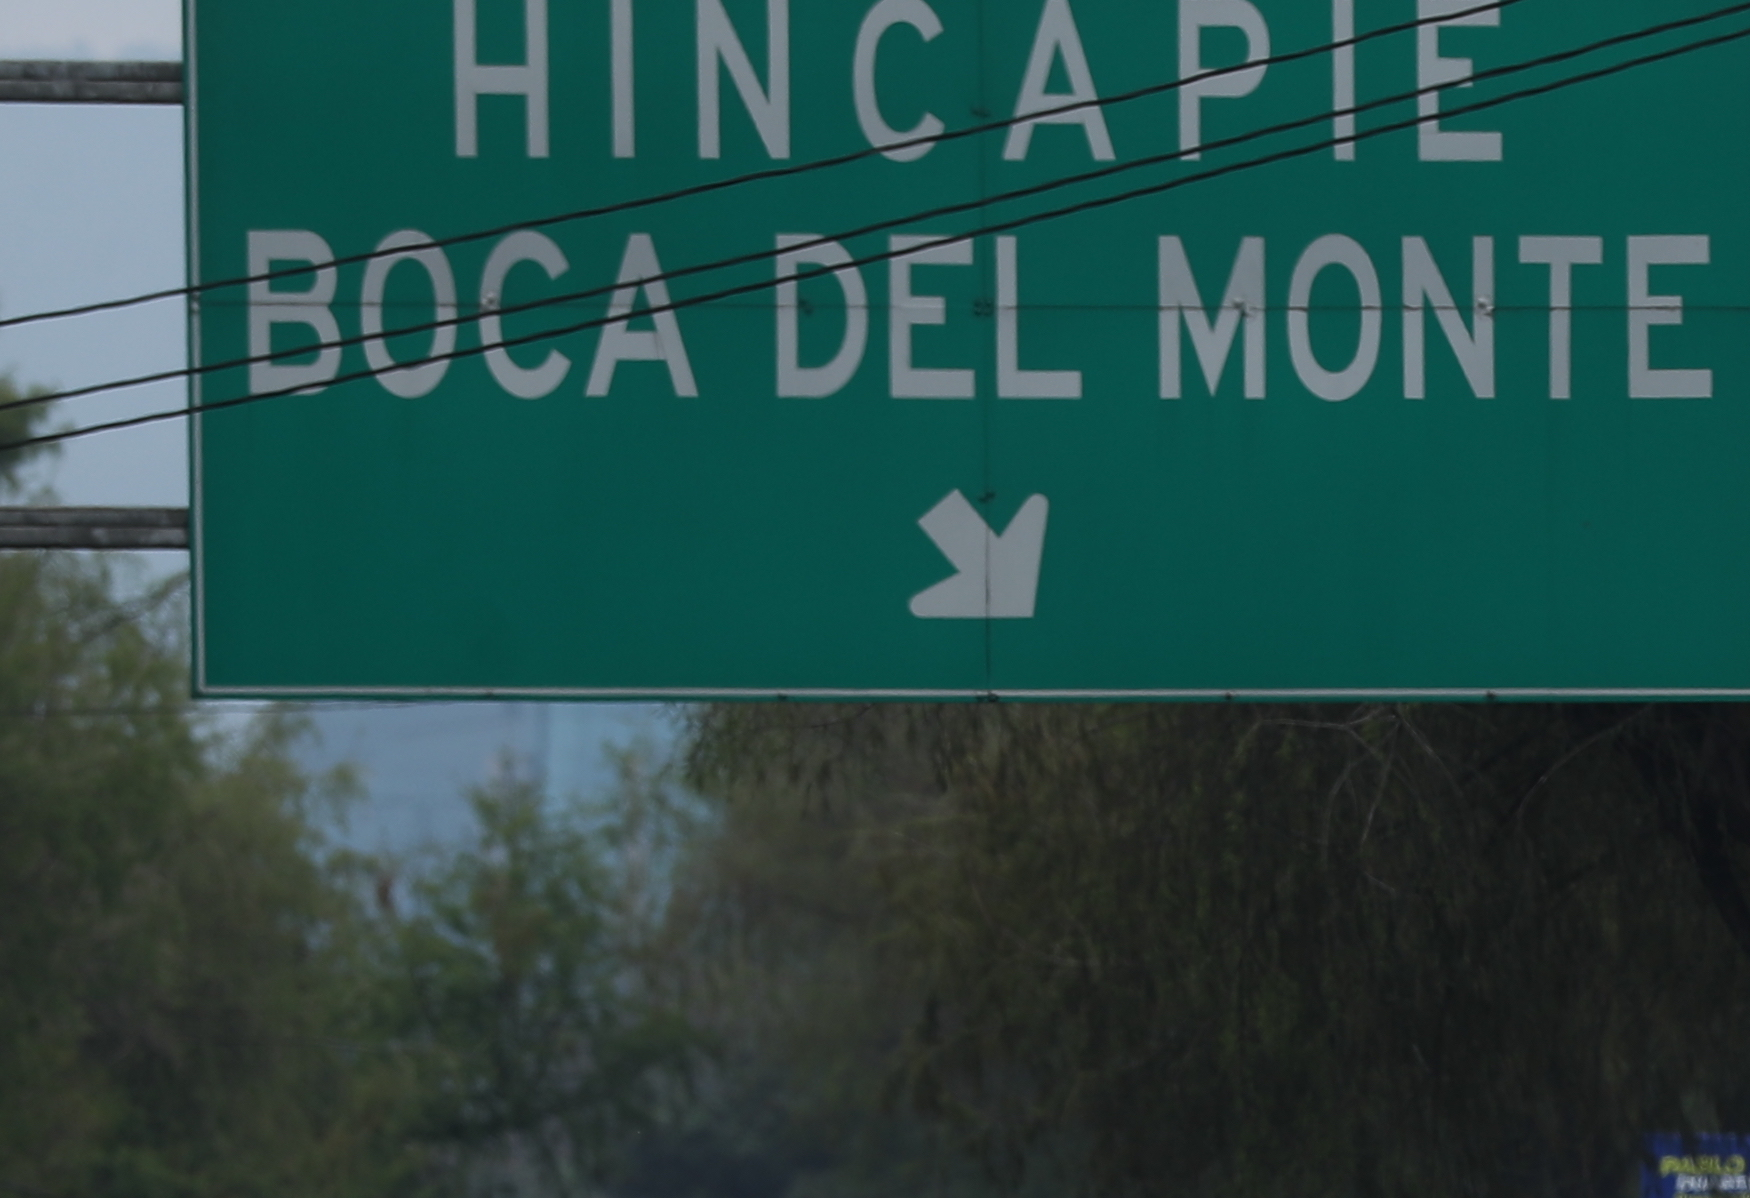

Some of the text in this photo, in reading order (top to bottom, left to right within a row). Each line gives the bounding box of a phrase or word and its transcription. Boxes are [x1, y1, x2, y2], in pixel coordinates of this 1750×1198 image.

[455, 0, 1503, 162] HINCAPIE
[247, 229, 1714, 402] BOCA DEL MONTE
